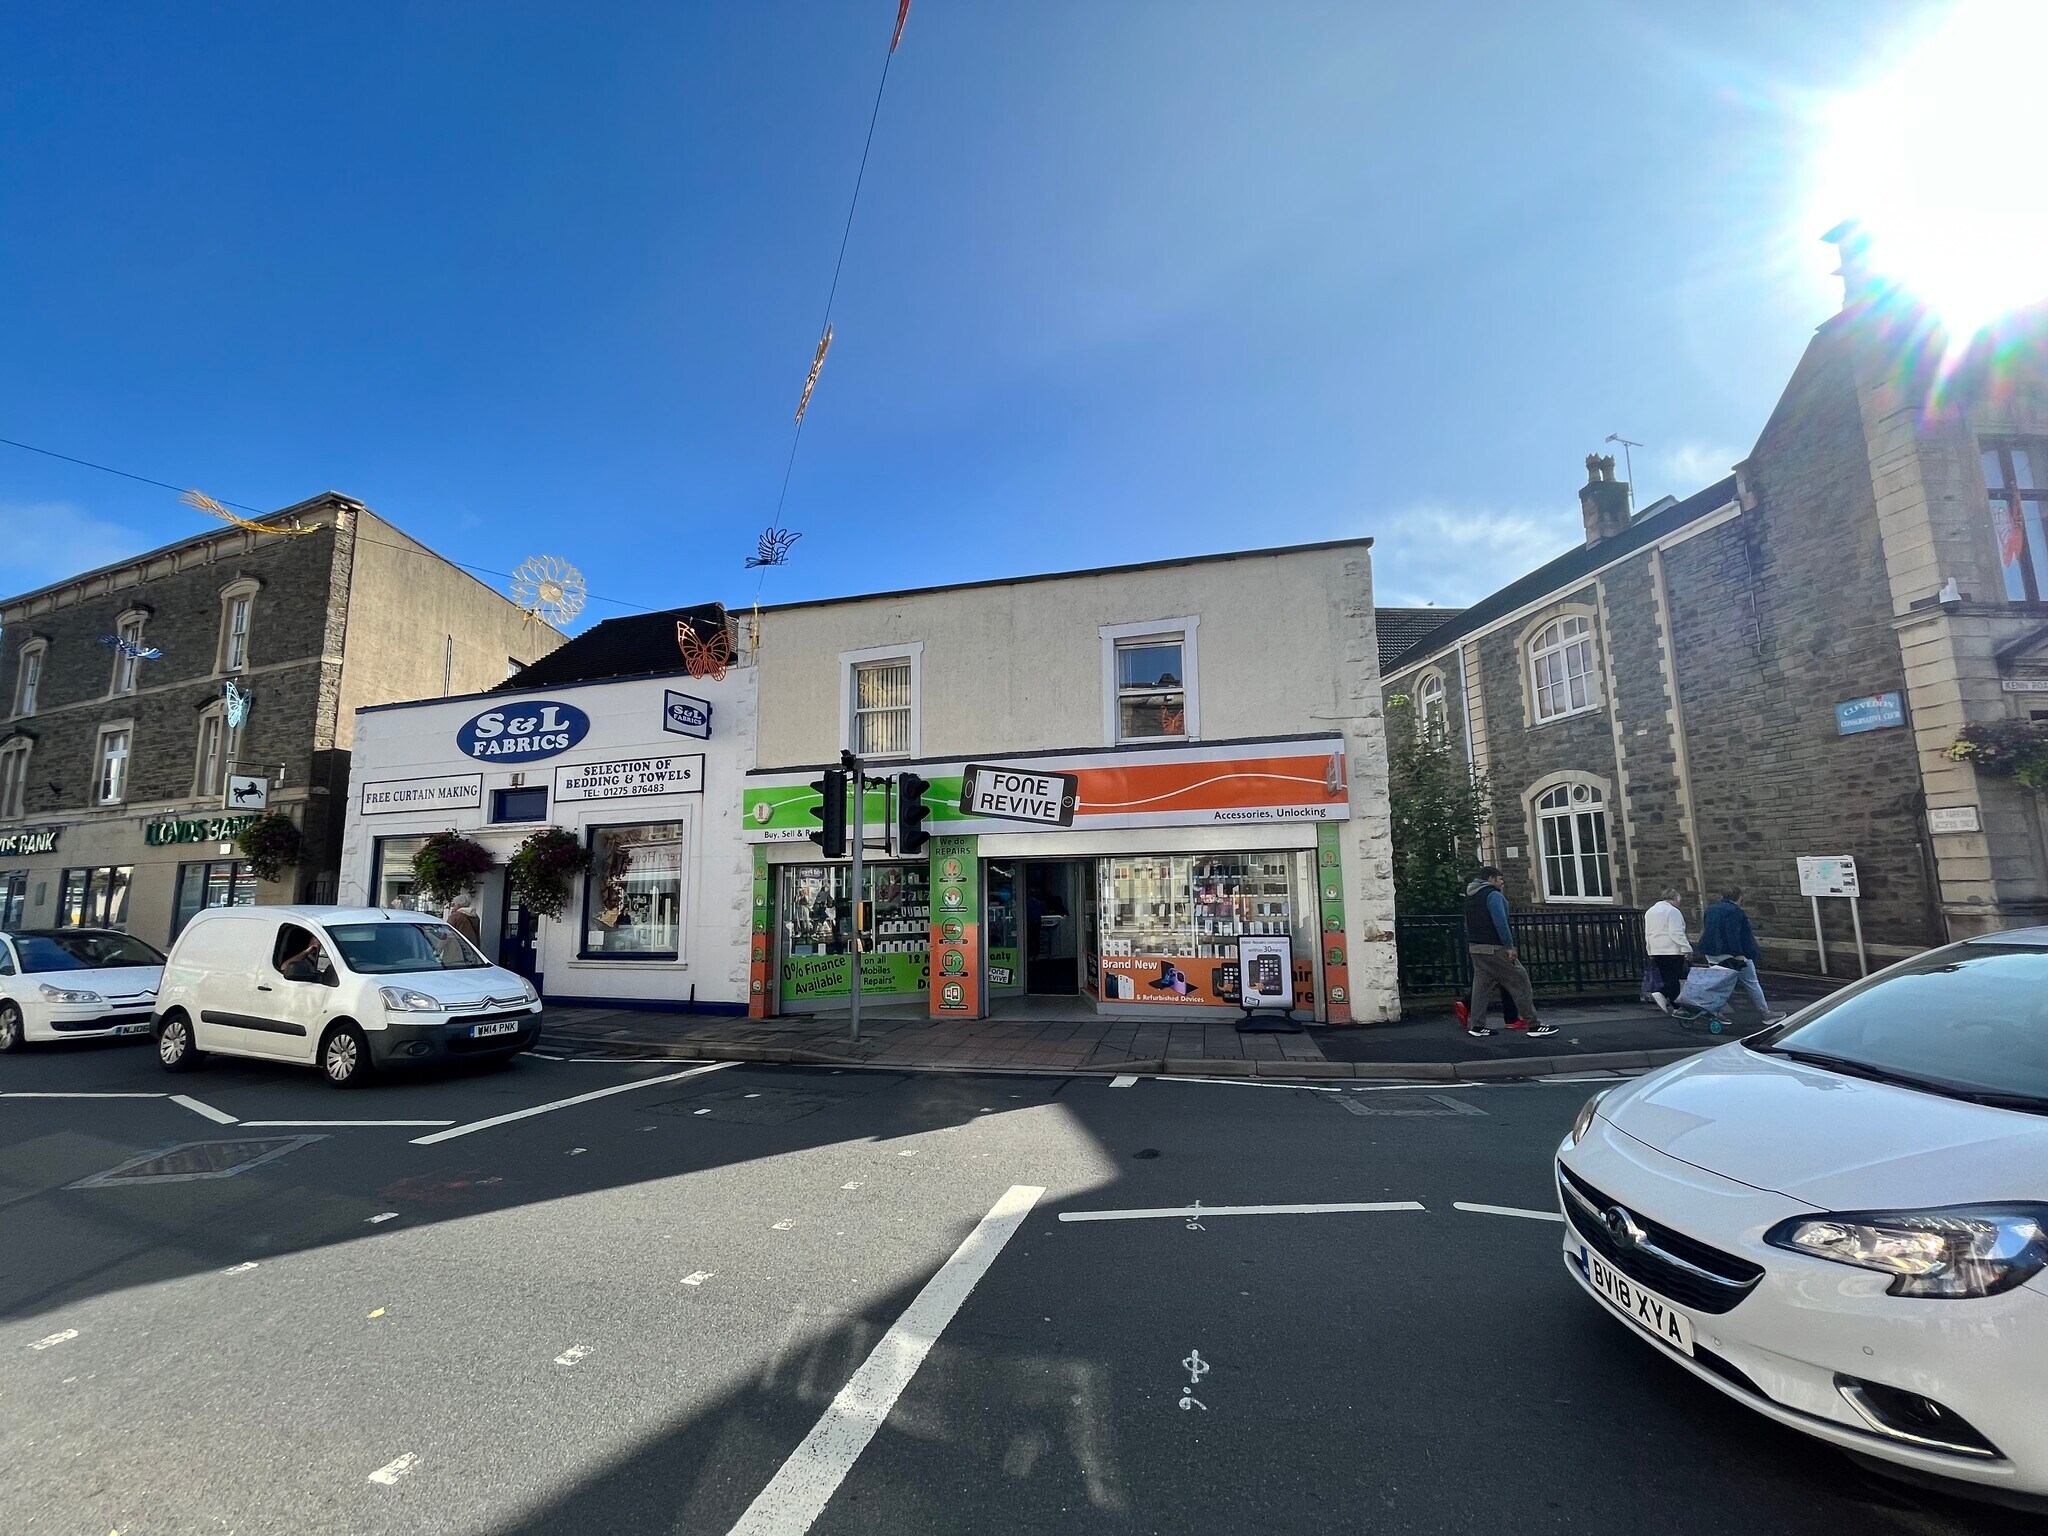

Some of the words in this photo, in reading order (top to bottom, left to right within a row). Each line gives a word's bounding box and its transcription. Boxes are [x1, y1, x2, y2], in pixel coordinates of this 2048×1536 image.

[673, 705, 702, 719] S&L
[1844, 700, 1895, 716] CLEVEDON
[475, 706, 570, 738] S&L
[673, 713, 702, 725] FABRICS
[472, 733, 569, 757] FABRICS
[583, 760, 651, 777] SELECTION
[655, 759, 672, 770] OF
[566, 775, 620, 789] BEDDING
[624, 774, 634, 784] &
[639, 769, 692, 783] TOWELS
[365, 791, 391, 804] FREE
[393, 788, 436, 802] CURTAIN
[437, 784, 478, 799] MAKING
[583, 788, 600, 798] TEL:
[603, 786, 628, 797] 01275
[631, 783, 665, 795] 876483
[980, 793, 1057, 818] REVIVE
[1214, 809, 1273, 820] Accessories,
[1276, 807, 1327, 818] Unlocking
[781, 829, 795, 838] Sell
[796, 829, 803, 837] &
[939, 837, 953, 846] We
[954, 837, 965, 845] do
[935, 847, 971, 855] REPAIRS
[864, 957, 875, 965] on
[877, 955, 887, 964] all
[908, 954, 920, 964] 12
[990, 951, 1011, 963] anty
[804, 957, 847, 975] Finance
[860, 965, 891, 975] Mobiles
[1102, 959, 1131, 969] Brand
[1135, 960, 1158, 970] New
[795, 971, 844, 996] Available
[1142, 993, 1179, 1002] Refurbished
[1180, 995, 1205, 1003] Devices
[477, 1024, 497, 1036] WM14
[499, 1022, 516, 1033] PNK
[1593, 1258, 1632, 1309] BV18
[1635, 1289, 1683, 1344] XYA
